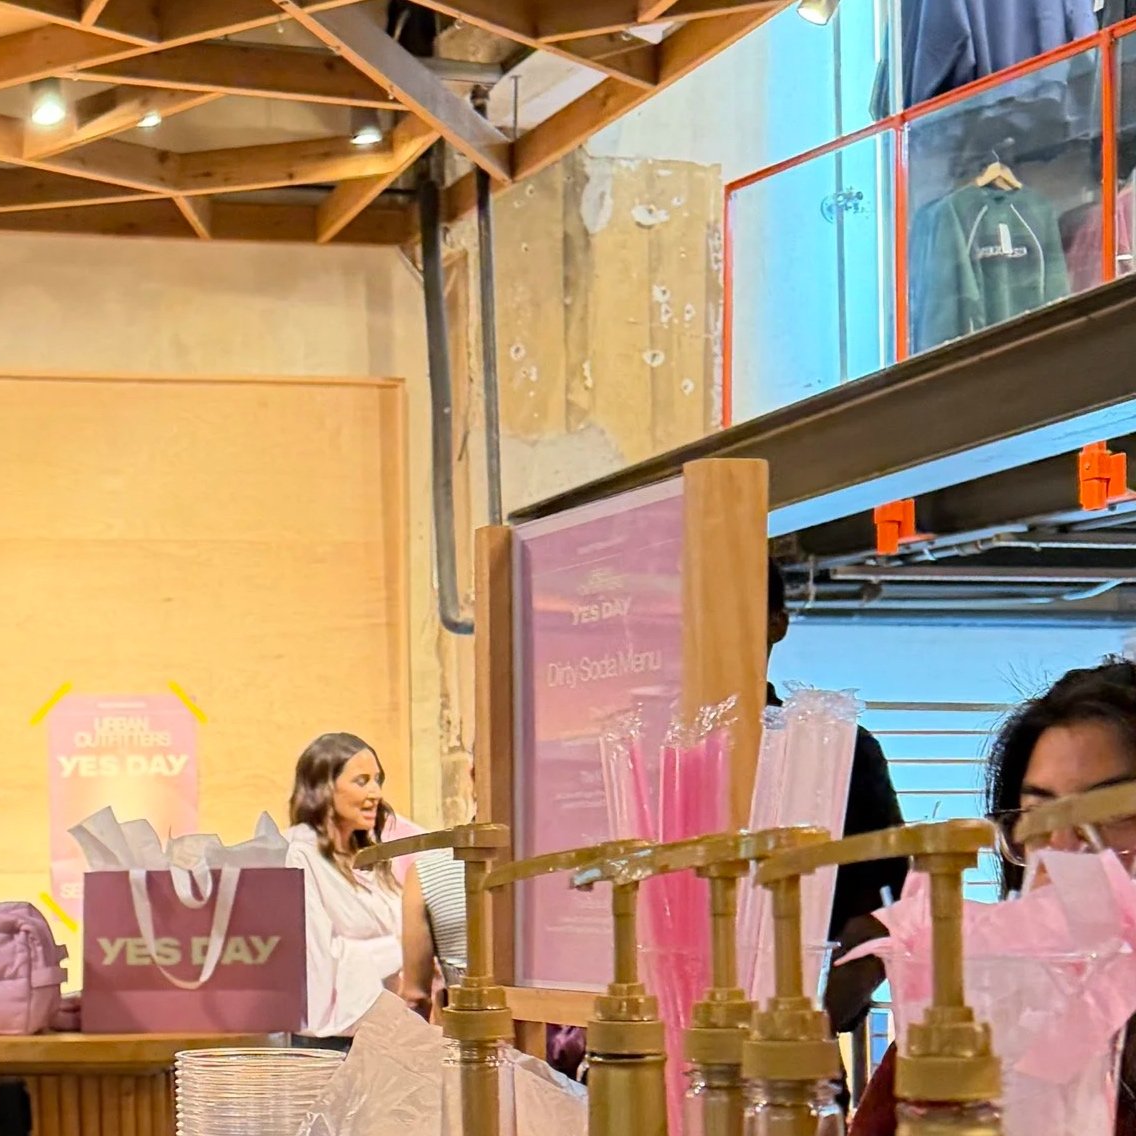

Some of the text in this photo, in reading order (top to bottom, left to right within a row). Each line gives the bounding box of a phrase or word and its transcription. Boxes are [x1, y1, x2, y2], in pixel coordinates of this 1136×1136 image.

[571, 597, 632, 625] YES DAY
[547, 650, 661, 688] Dirty Soda Menu
[93, 715, 149, 733] URBAN
[74, 732, 172, 748] OUTFITTERS
[58, 755, 189, 777] YES DAY
[97, 936, 281, 967] YES DAY
